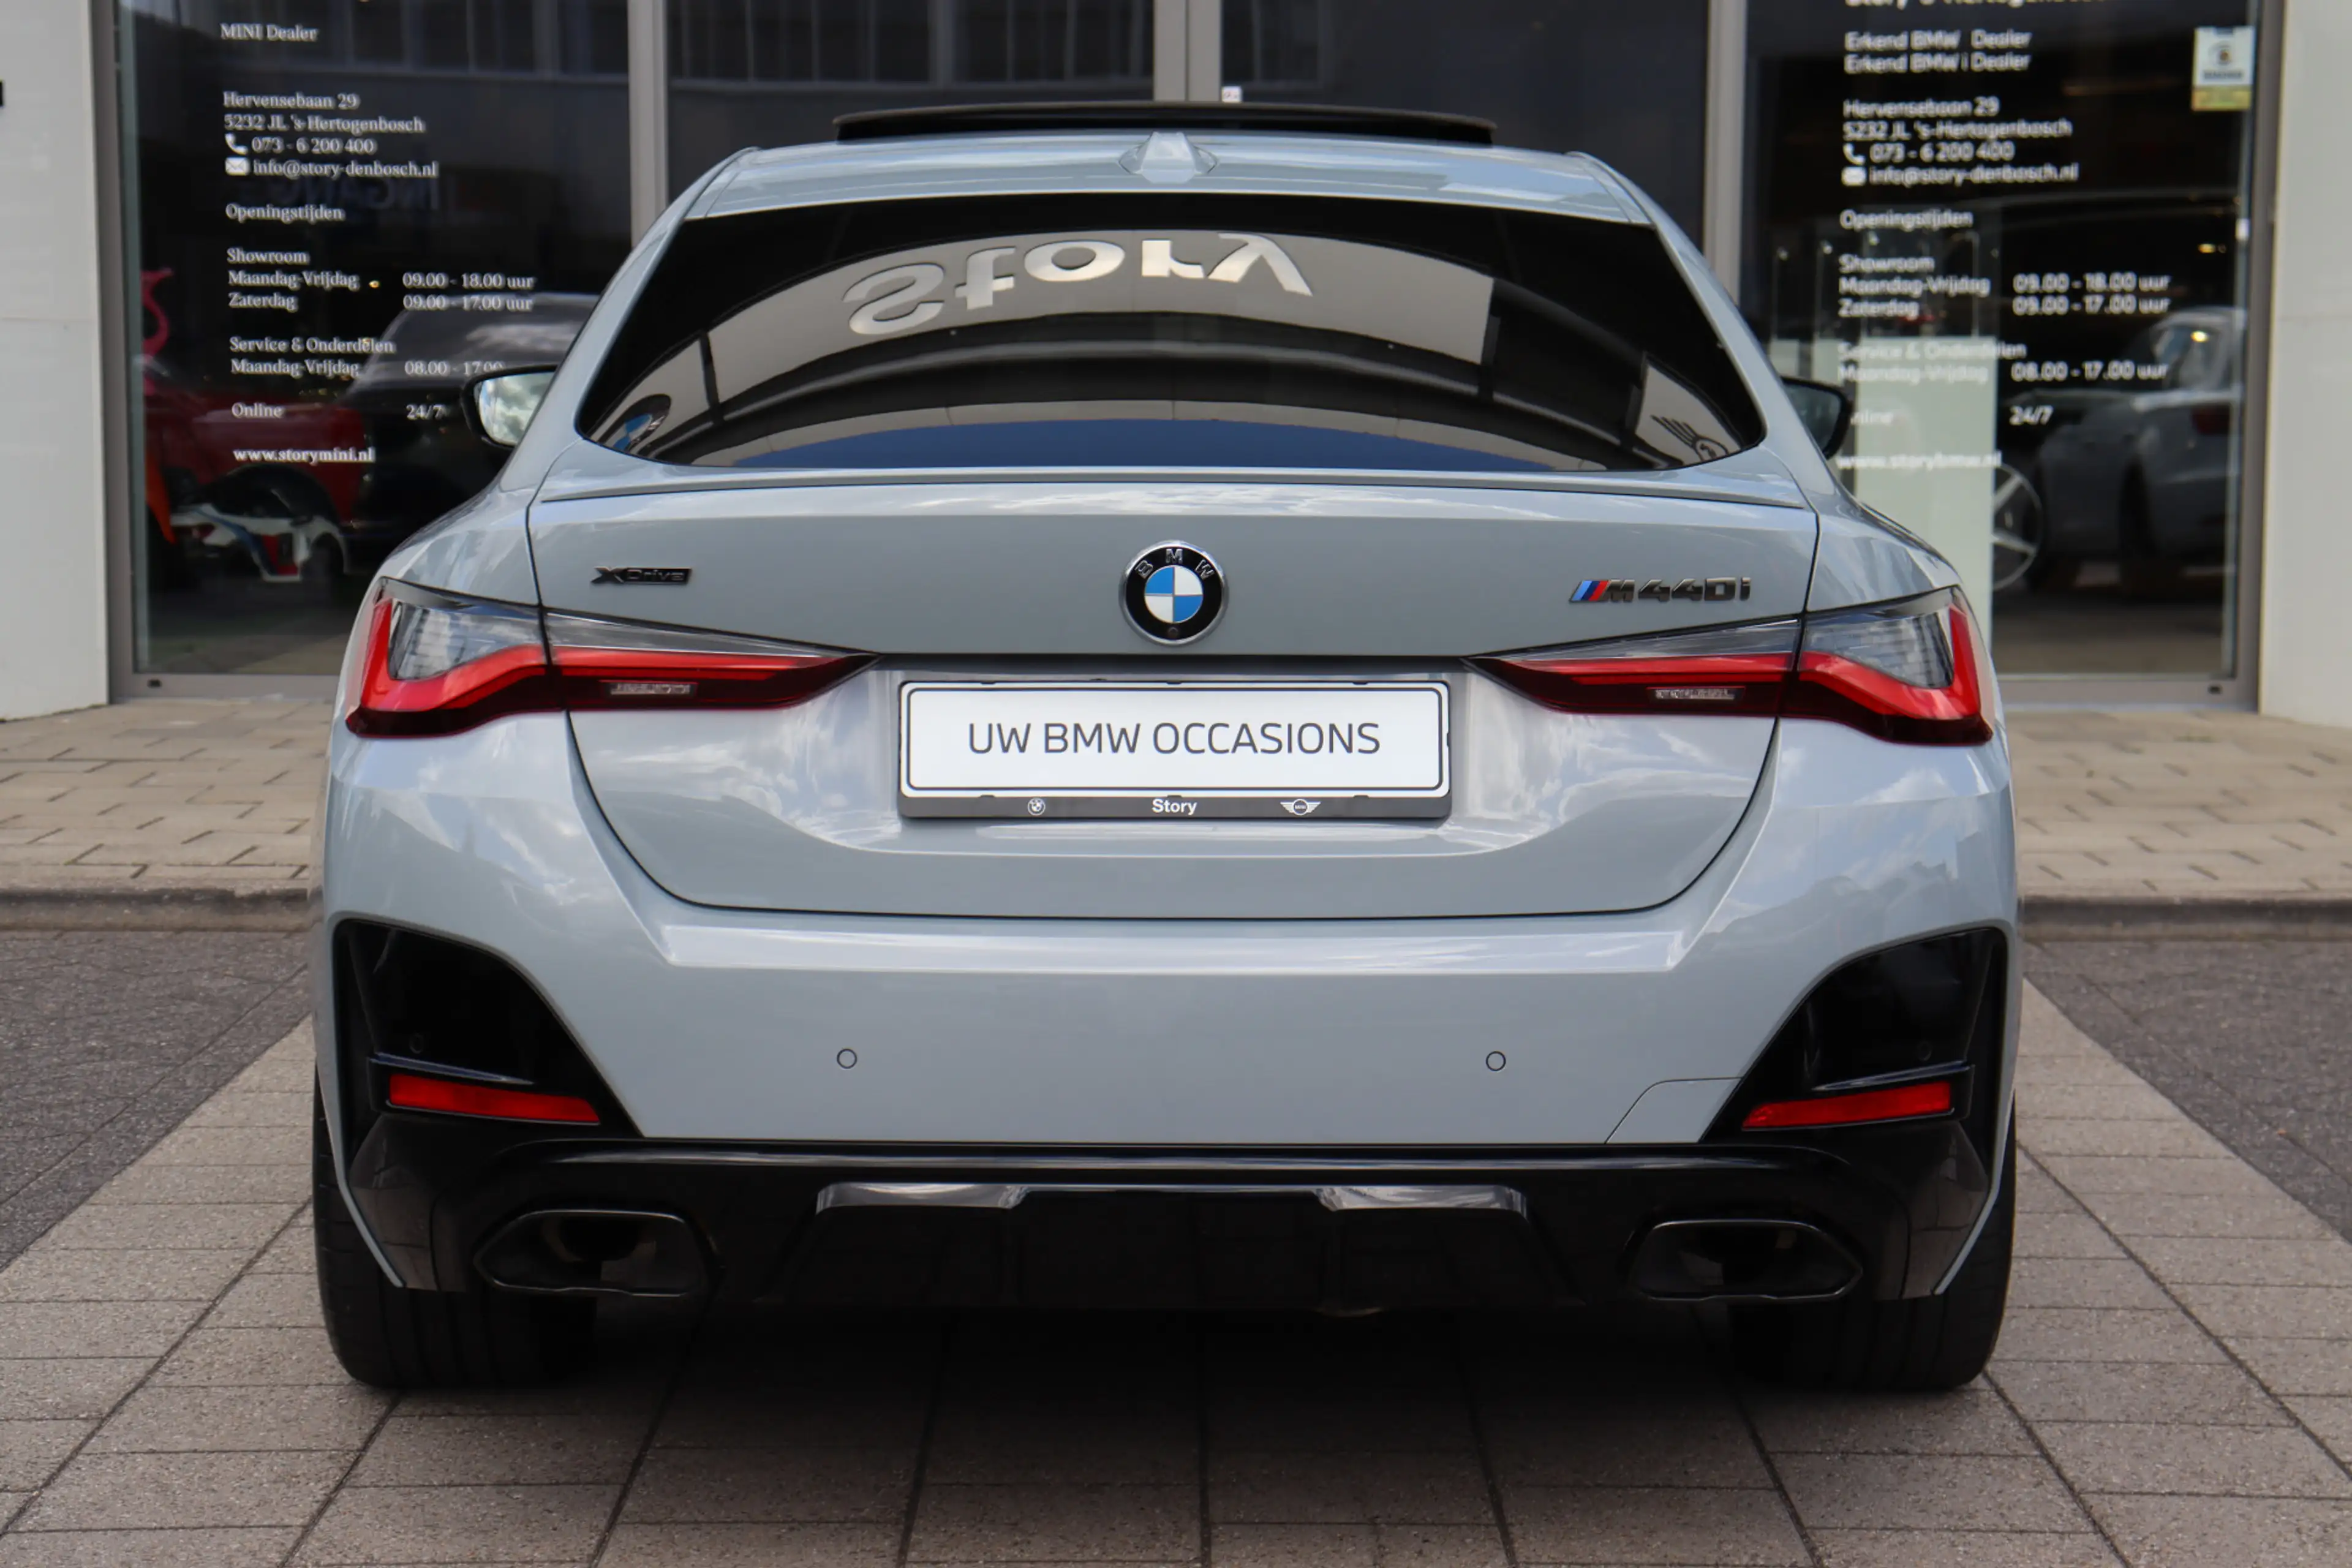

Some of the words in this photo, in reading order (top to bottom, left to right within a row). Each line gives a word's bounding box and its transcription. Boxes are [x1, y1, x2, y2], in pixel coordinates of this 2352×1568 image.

[220, 23, 263, 40] MINI
[266, 24, 318, 42] Dealer
[1844, 31, 1908, 51] Erkend
[1910, 30, 1961, 50] BMW
[1970, 28, 2032, 48] Dealer
[1844, 53, 1908, 74] Erkend
[1910, 53, 1959, 72] BMW
[1970, 51, 2031, 71] Dealer
[223, 91, 335, 109] Hervensebaan
[337, 93, 360, 109] 29
[1843, 98, 1972, 119] Hervensebaan
[1973, 96, 2000, 116] 29
[224, 113, 265, 130] 5232
[267, 115, 289, 131] JL
[1842, 120, 1888, 141] 5232
[1890, 121, 1912, 141] JL
[251, 137, 284, 153] 073
[296, 137, 309, 153] 6
[311, 137, 342, 154] 200
[344, 138, 377, 154] 400
[1869, 143, 1906, 163] 073
[1919, 143, 1935, 162] 6
[1936, 141, 1974, 162] 200
[1975, 140, 2016, 161] 400
[253, 159, 440, 180] info@story-denbosch.nl
[1869, 162, 2080, 187] info@story-denbosch.nl
[225, 203, 346, 224] Openingstijden
[1840, 209, 1973, 232] Openingstijden
[227, 247, 311, 265] Showroom
[1839, 254, 1935, 273] Showroom
[228, 270, 360, 291] Maandag-Vrijdag
[402, 272, 448, 288] 09.00
[461, 273, 507, 289] 18.00
[507, 276, 537, 290] uur
[1838, 275, 1991, 298] Maandag-Vrijdag
[2013, 273, 2070, 293] 09.00
[2083, 271, 2137, 292] 18.00
[2138, 275, 2171, 292] uur
[228, 292, 298, 313] Zaterdag
[402, 294, 448, 311] 09.00
[462, 295, 503, 312] 17.00
[505, 298, 534, 312] uur
[1838, 297, 1919, 320] Zaterdag
[2012, 295, 2069, 316] 09.00
[2082, 293, 2137, 314] 17.00
[2138, 297, 2171, 314] uur
[230, 336, 290, 353] Service
[291, 337, 304, 353] &
[306, 337, 397, 354] Onderdelen
[230, 358, 361, 379] Maandag-Vrijdag
[404, 360, 451, 377] 08.00
[2011, 361, 2068, 382] 08.00
[2082, 360, 2135, 380] 17.00
[2136, 363, 2168, 380] uur
[232, 401, 285, 419] Online
[405, 404, 447, 421] 24/7
[2010, 404, 2053, 426] 24/7
[233, 447, 376, 466] www.storymini.nl
[1134, 549, 1215, 579] BMW
[968, 723, 1031, 755] UW
[1044, 722, 1140, 755] BMW
[1152, 722, 1381, 755] OCCASIONS
[1152, 799, 1197, 815] Story
